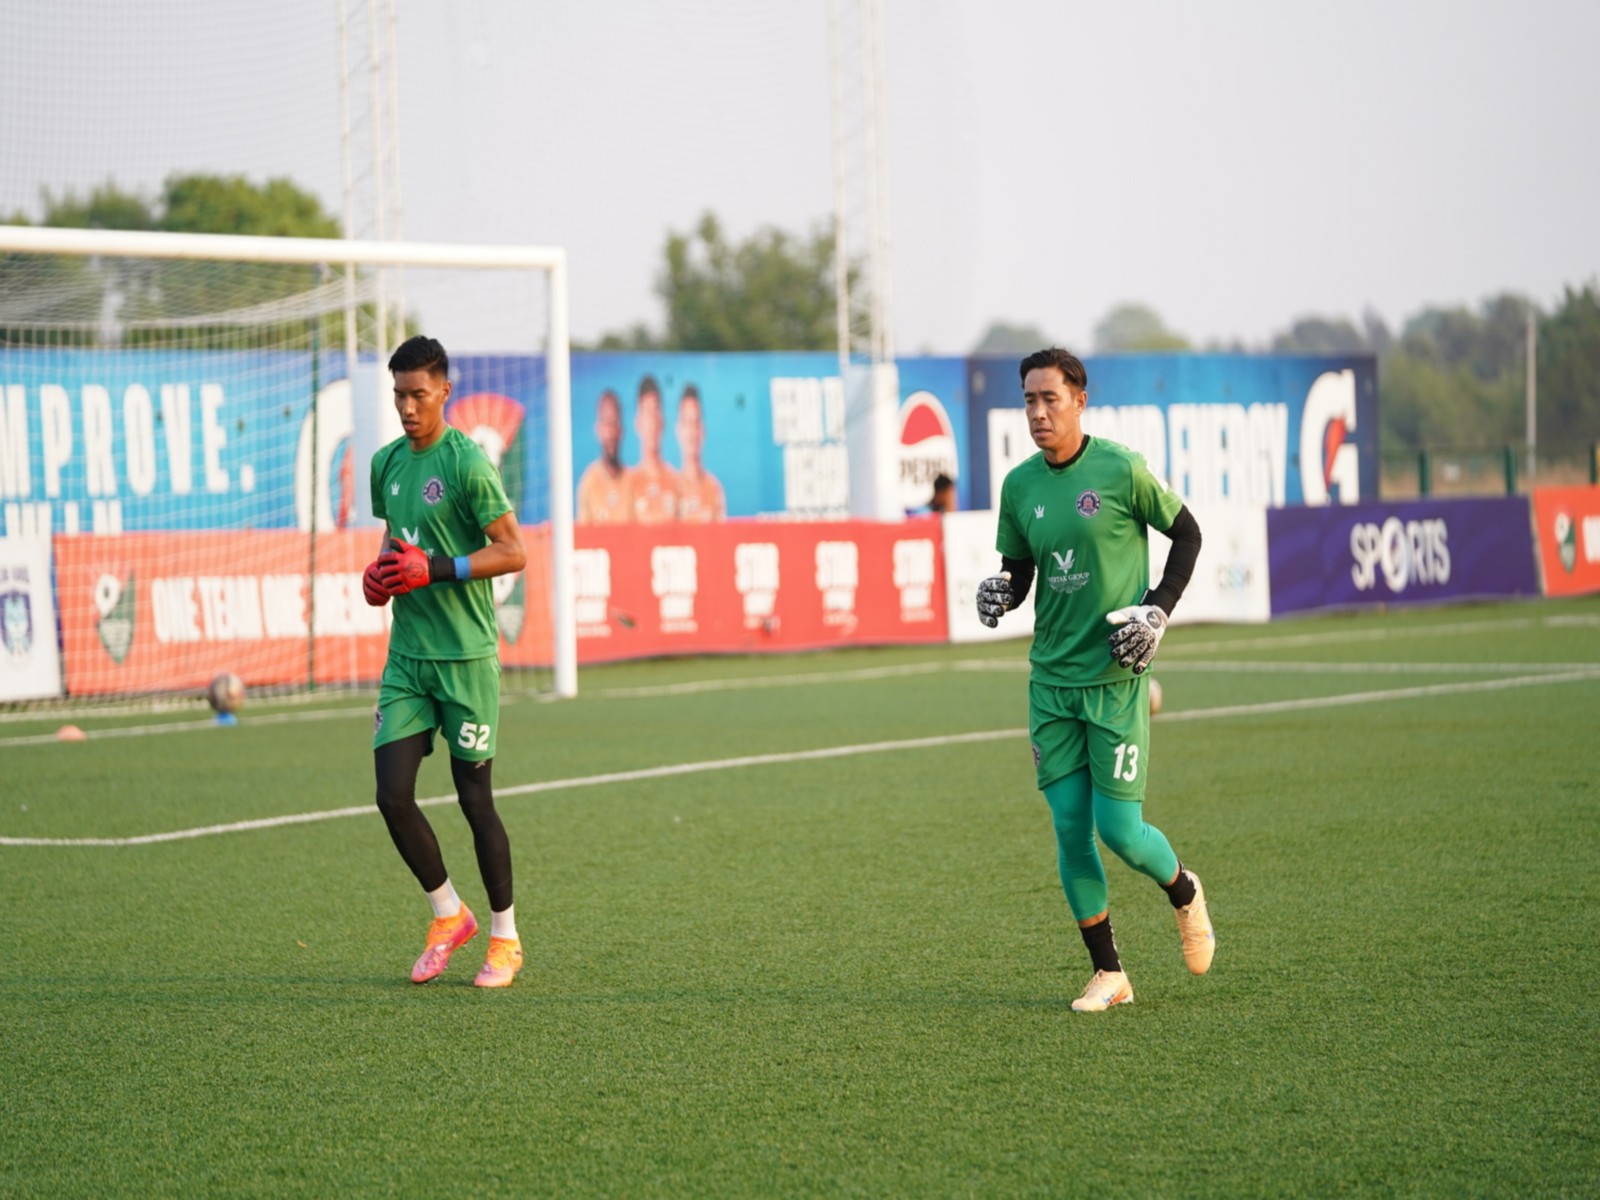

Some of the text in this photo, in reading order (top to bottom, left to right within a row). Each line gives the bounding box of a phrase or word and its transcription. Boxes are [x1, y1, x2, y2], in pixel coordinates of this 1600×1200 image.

[1350, 516, 1451, 593] SPORTS
[458, 721, 491, 751] 52
[1113, 743, 1139, 782] 13
